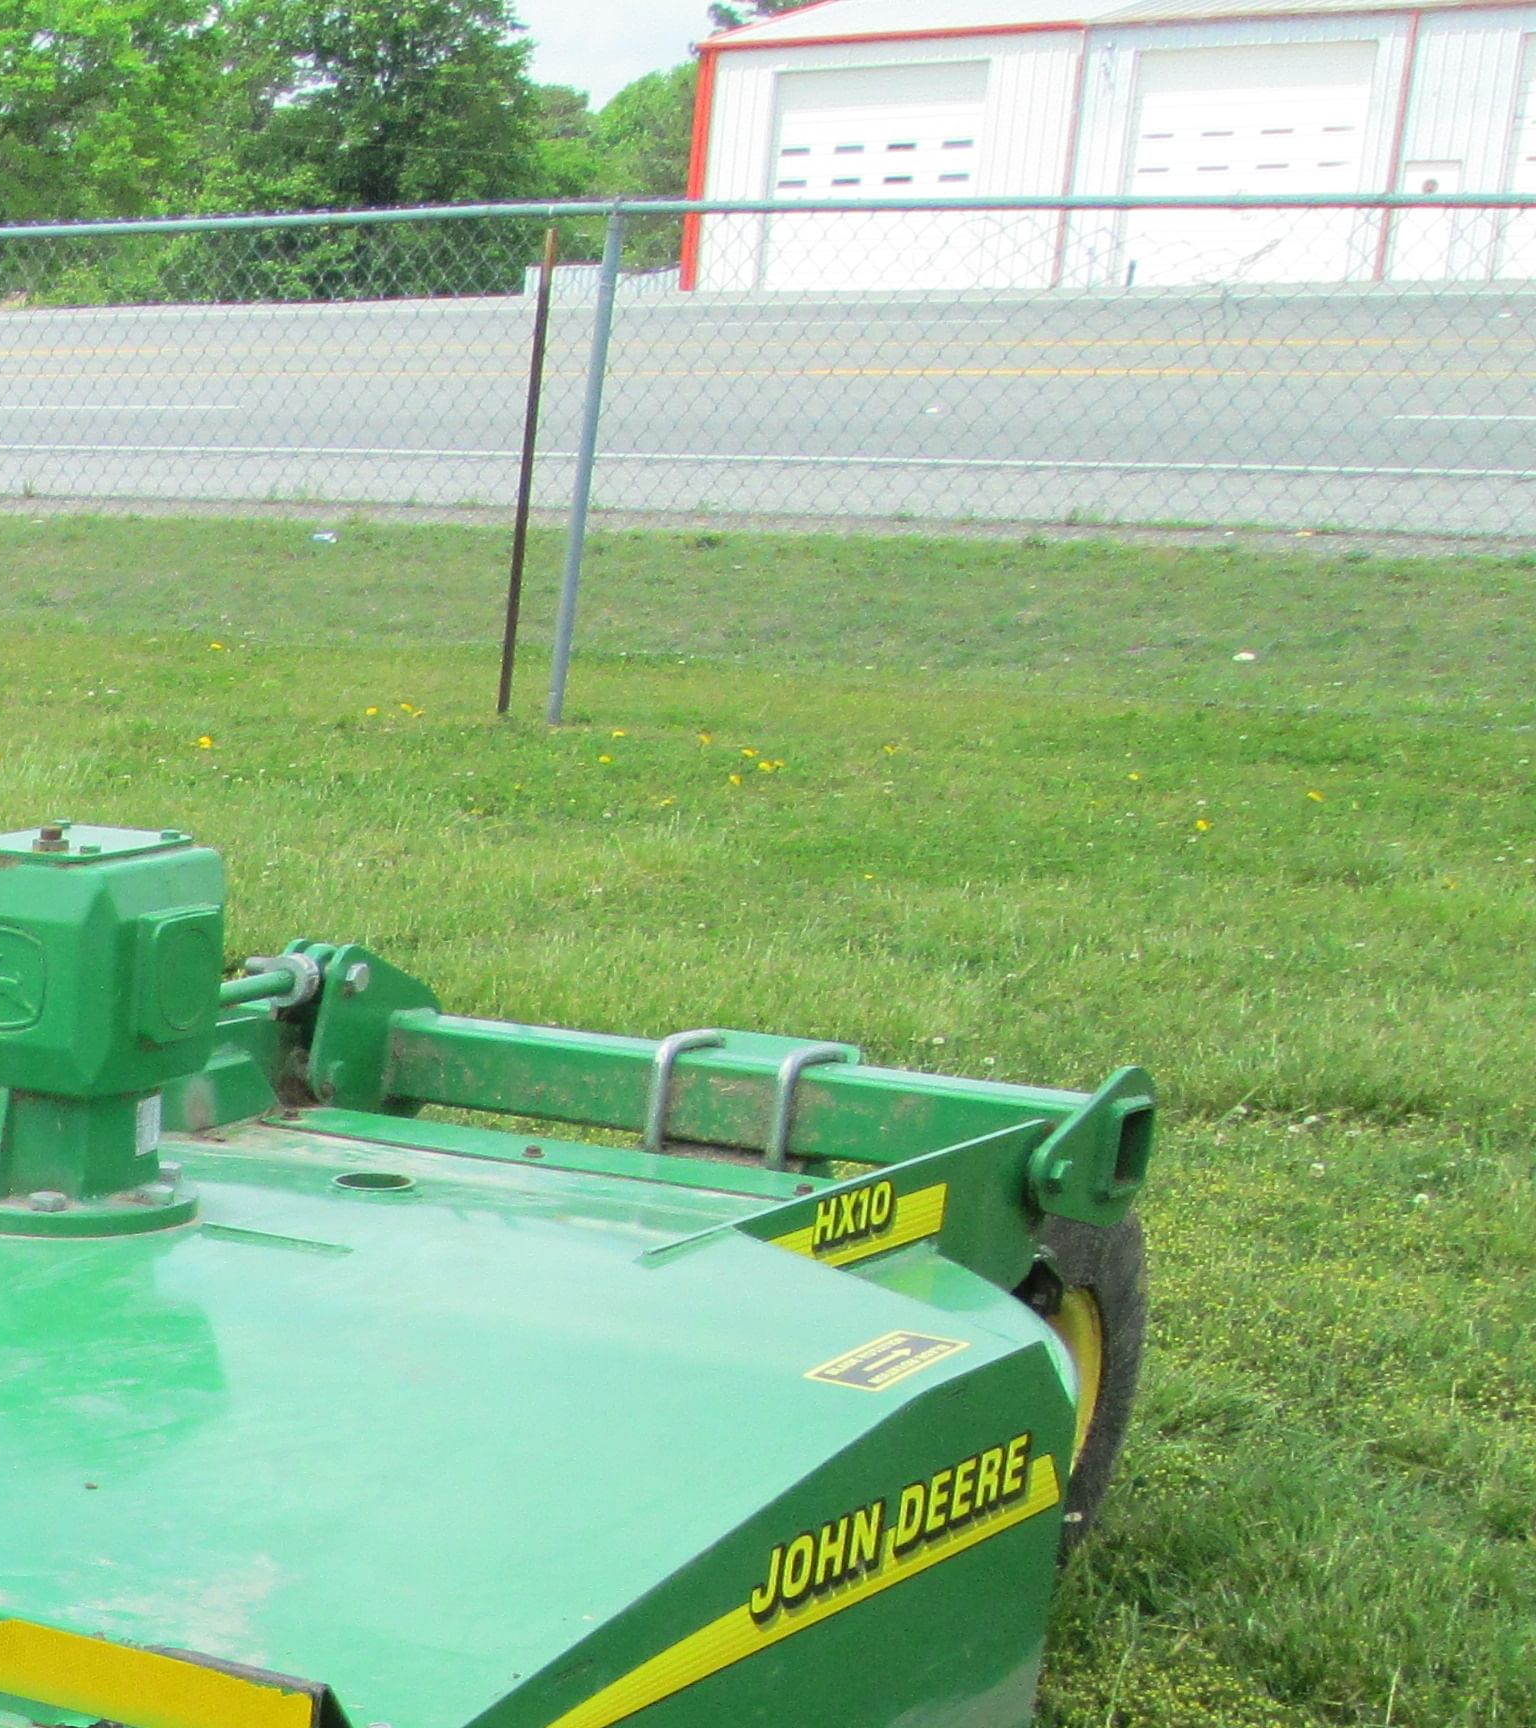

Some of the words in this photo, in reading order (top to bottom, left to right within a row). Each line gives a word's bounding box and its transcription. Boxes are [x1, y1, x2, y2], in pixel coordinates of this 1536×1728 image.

[813, 1180, 893, 1248] HX10
[749, 1500, 884, 1617] JOHN
[894, 1430, 1031, 1550] DEERE
